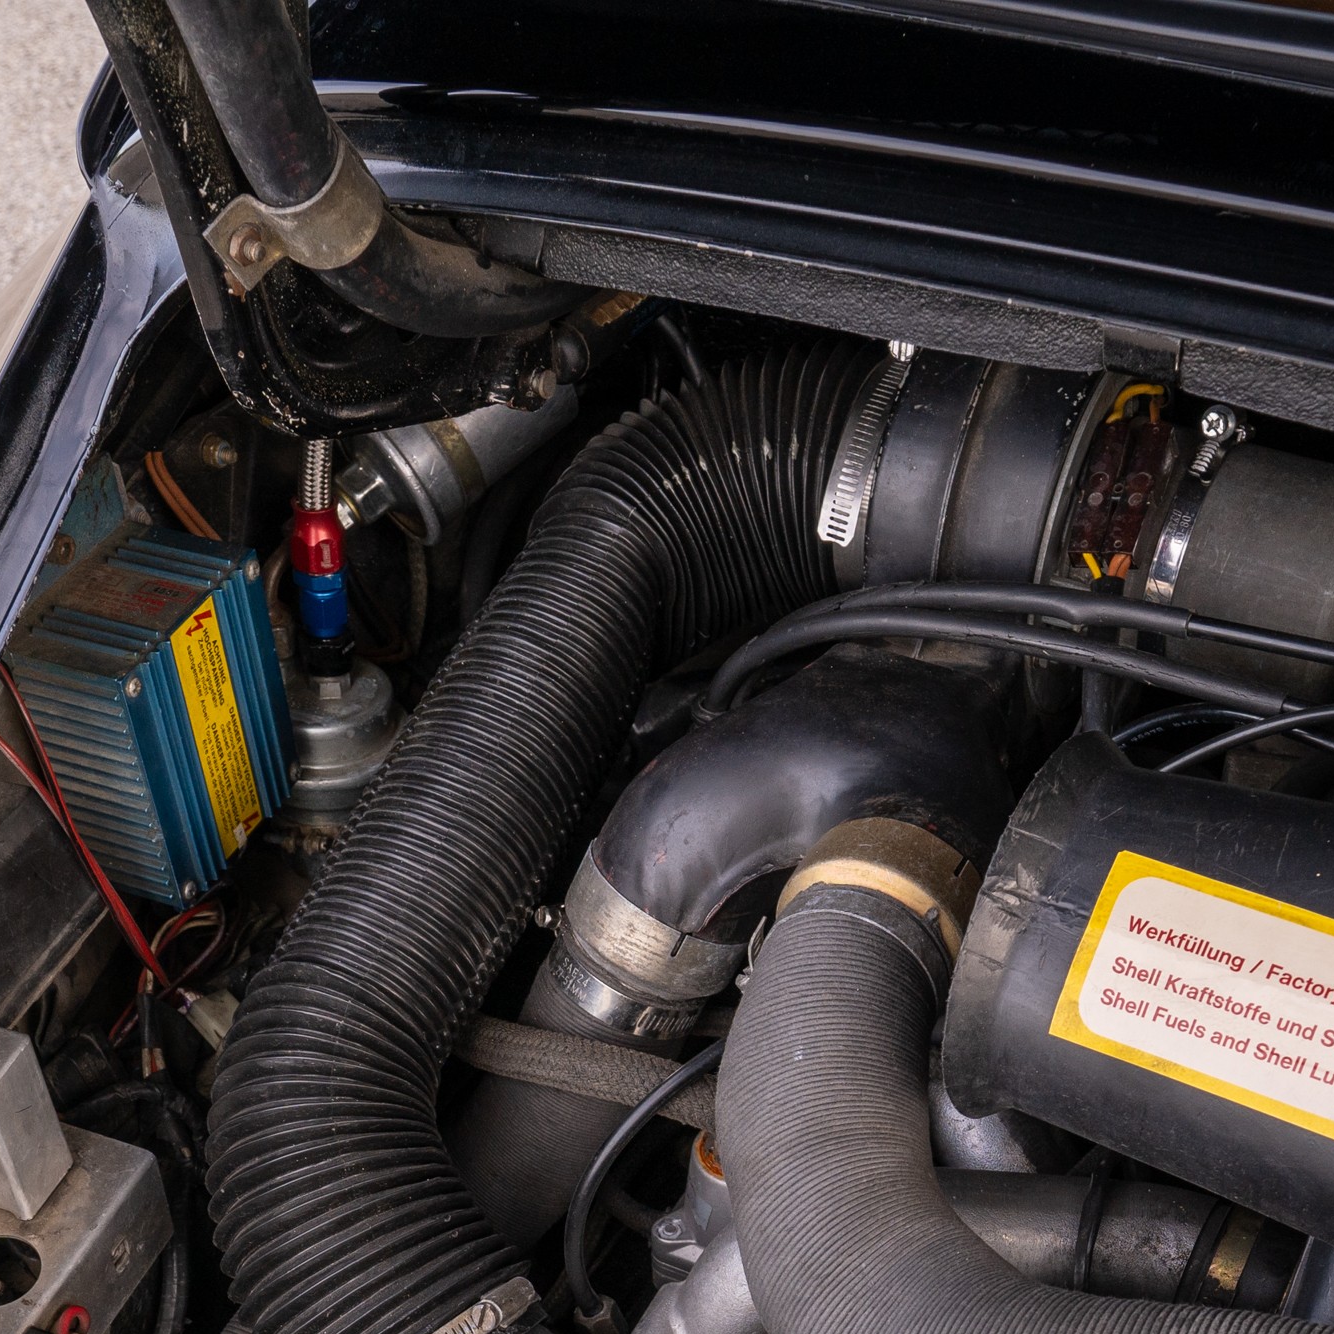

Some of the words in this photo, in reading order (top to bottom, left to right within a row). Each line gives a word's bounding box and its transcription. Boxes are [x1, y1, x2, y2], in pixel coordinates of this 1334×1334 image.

[203, 629, 225, 705] HOCHSPANNUNG
[211, 640, 226, 684] ACHTUNG
[210, 722, 225, 759] DANGER
[220, 761, 232, 790] HAUTE
[228, 707, 242, 743] DANGER
[237, 746, 248, 767] HIGH
[243, 769, 257, 807] VOLTAGE
[1129, 916, 1245, 972] Werkfüllung
[1250, 960, 1263, 973] /
[1101, 989, 1149, 1018] Shell
[1153, 1006, 1206, 1038] Fuels
[1210, 1032, 1250, 1053] and
[1254, 1043, 1306, 1073] Shell
[1112, 957, 1162, 986] Shell
[1164, 975, 1270, 1024] Kraftstoffe
[1277, 1018, 1317, 1040] und
